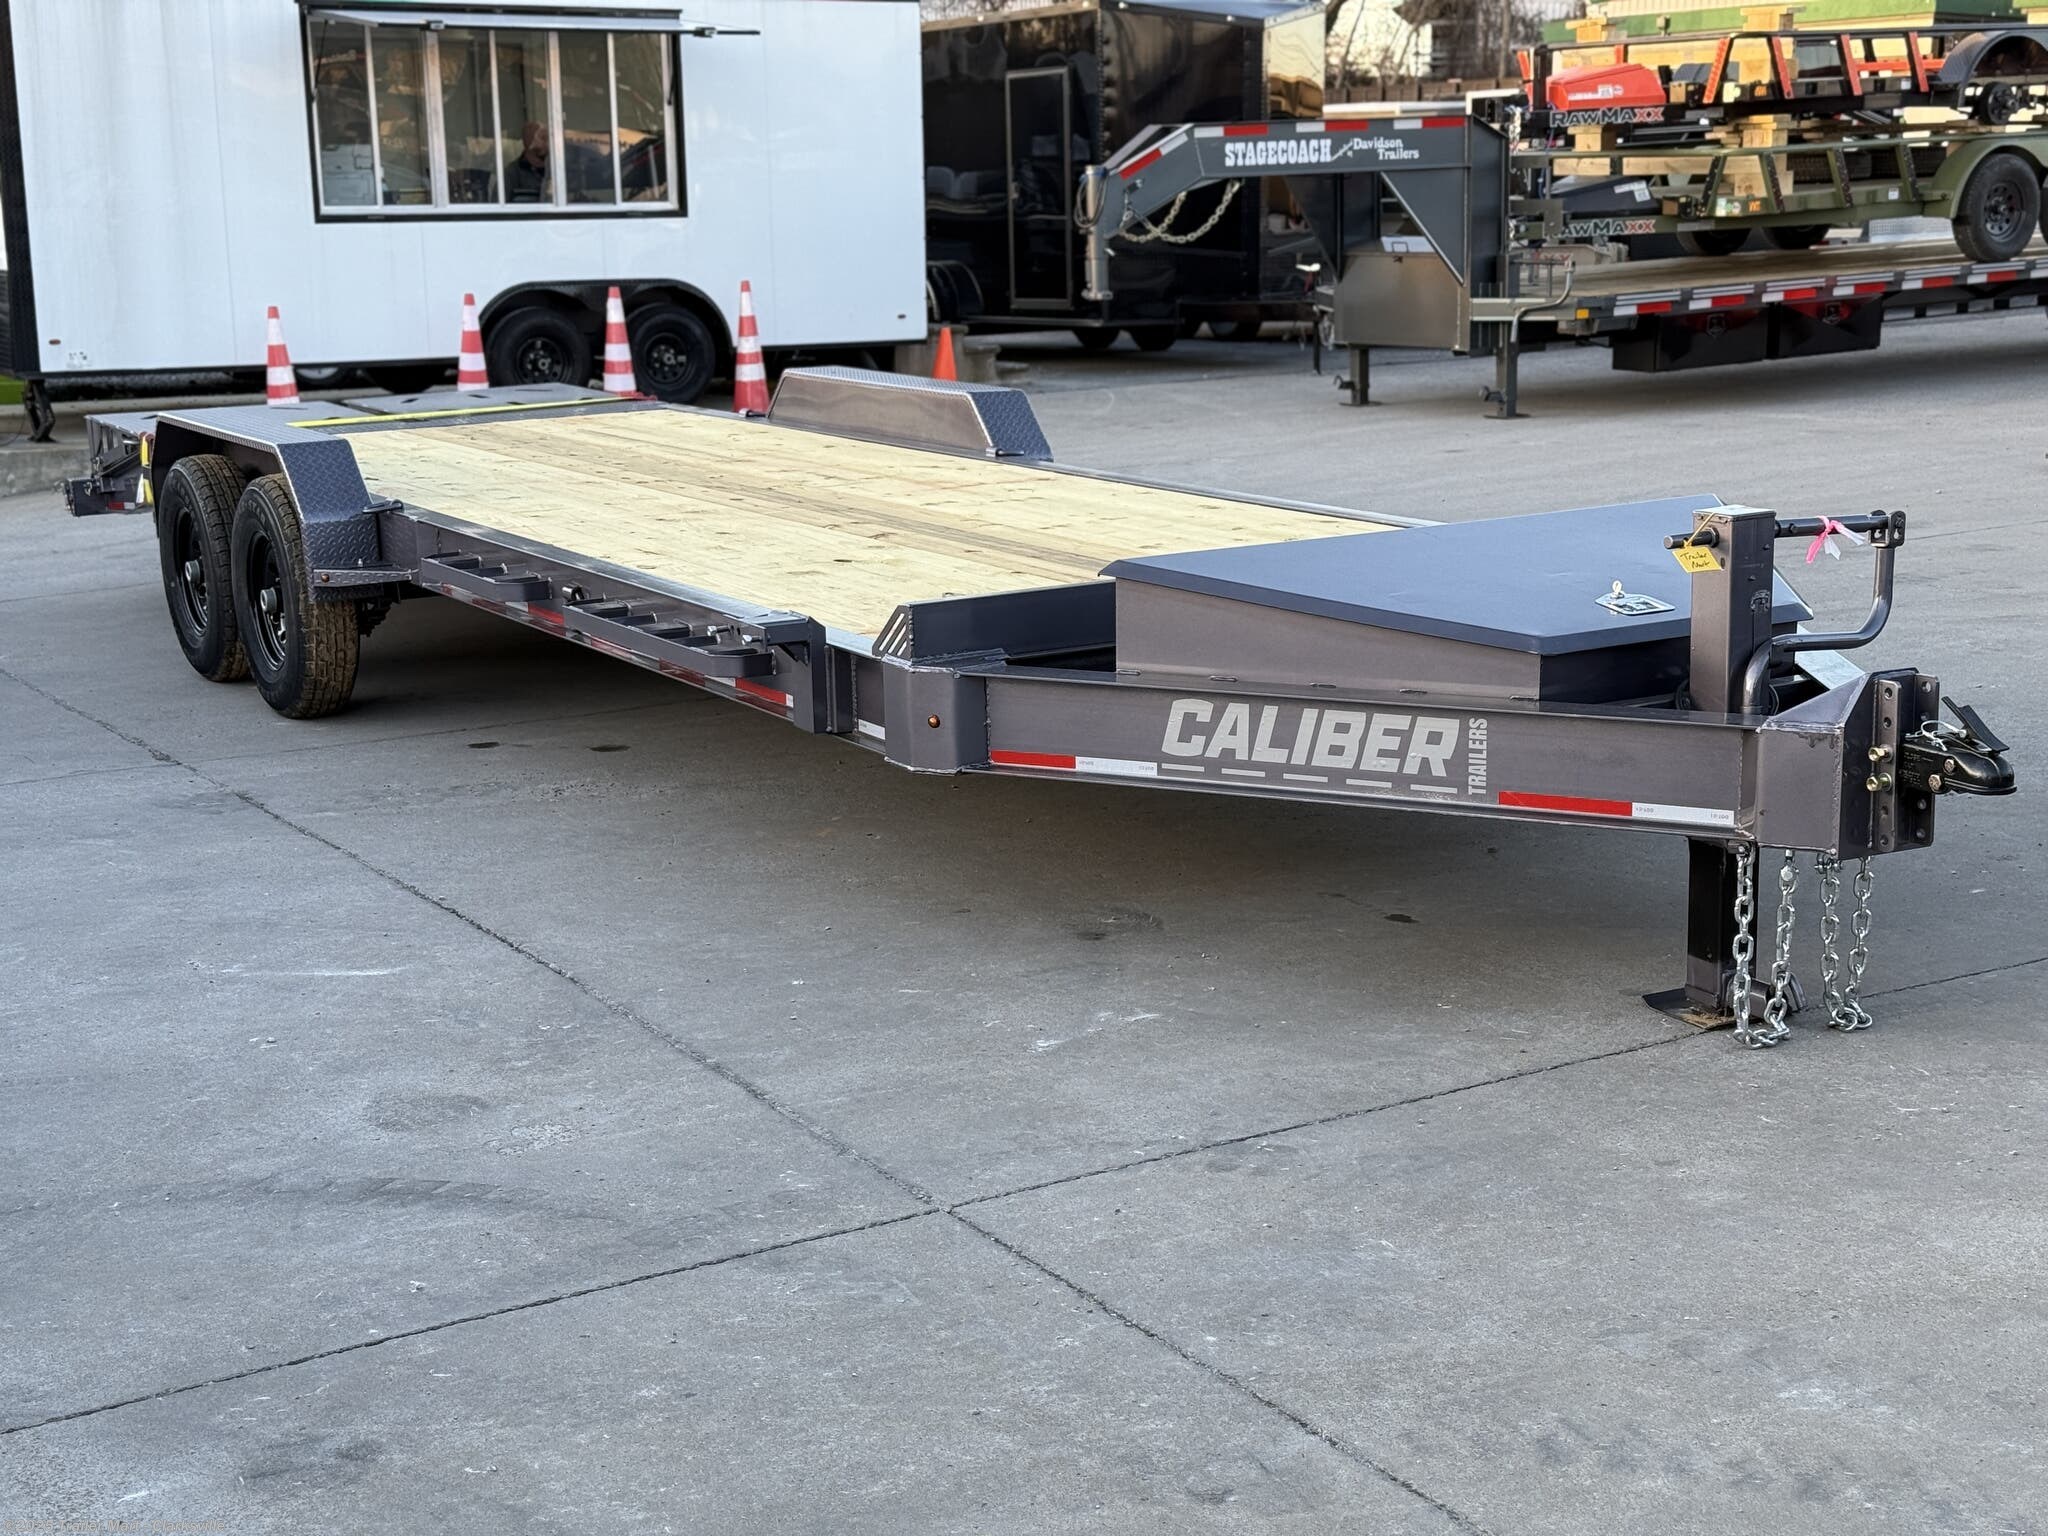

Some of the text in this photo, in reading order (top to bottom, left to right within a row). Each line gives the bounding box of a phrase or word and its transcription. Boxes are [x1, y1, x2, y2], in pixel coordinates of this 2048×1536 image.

[1225, 138, 1332, 167] STAGECOACH
[1353, 137, 1403, 150] Davidson
[1378, 149, 1420, 160] Trailers
[1555, 218, 1656, 238] AWMAXX
[1680, 552, 1707, 560] Trailer
[1161, 698, 1460, 777] CALIBER
[1468, 717, 1488, 795] TRAILERS
